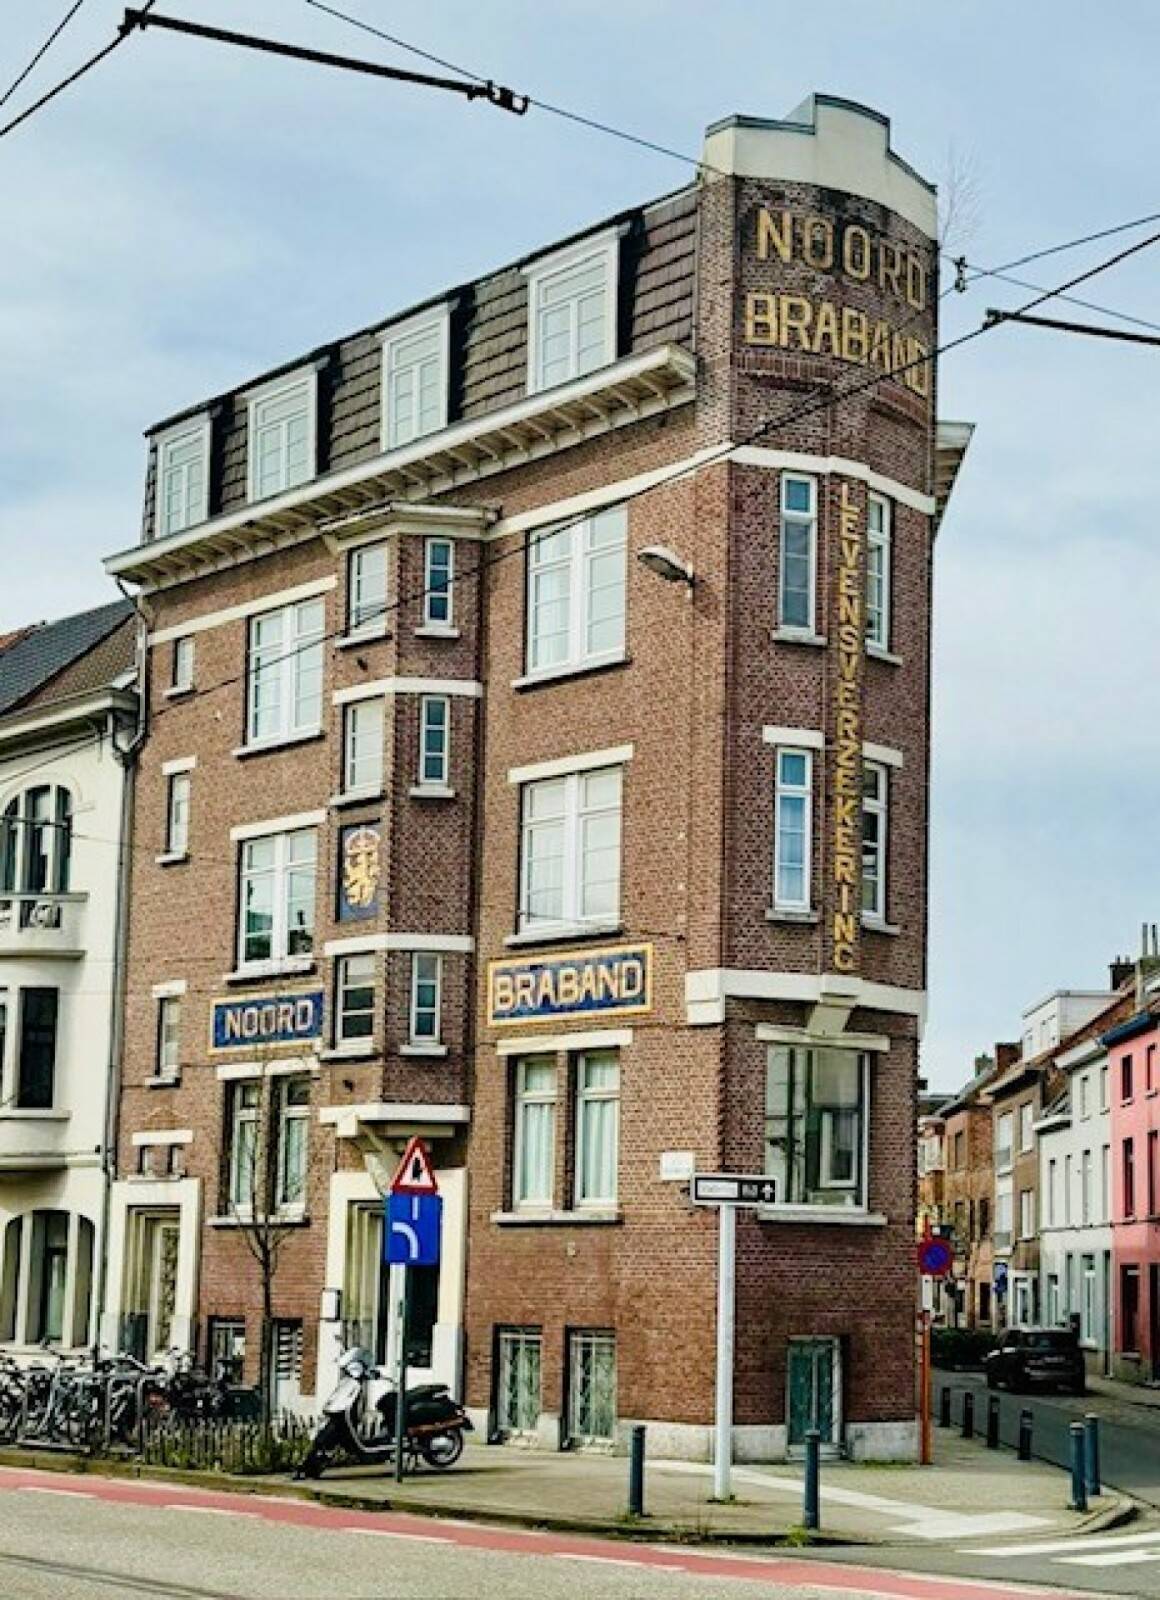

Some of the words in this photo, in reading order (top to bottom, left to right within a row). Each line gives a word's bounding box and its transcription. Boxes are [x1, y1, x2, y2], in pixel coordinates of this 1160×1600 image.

[757, 208, 926, 311] NOORD
[745, 294, 929, 397] BRABAND
[834, 482, 860, 970] LEVENSVERZEKERING
[224, 1001, 314, 1040] NOORD
[493, 960, 644, 1011] BRABAND
